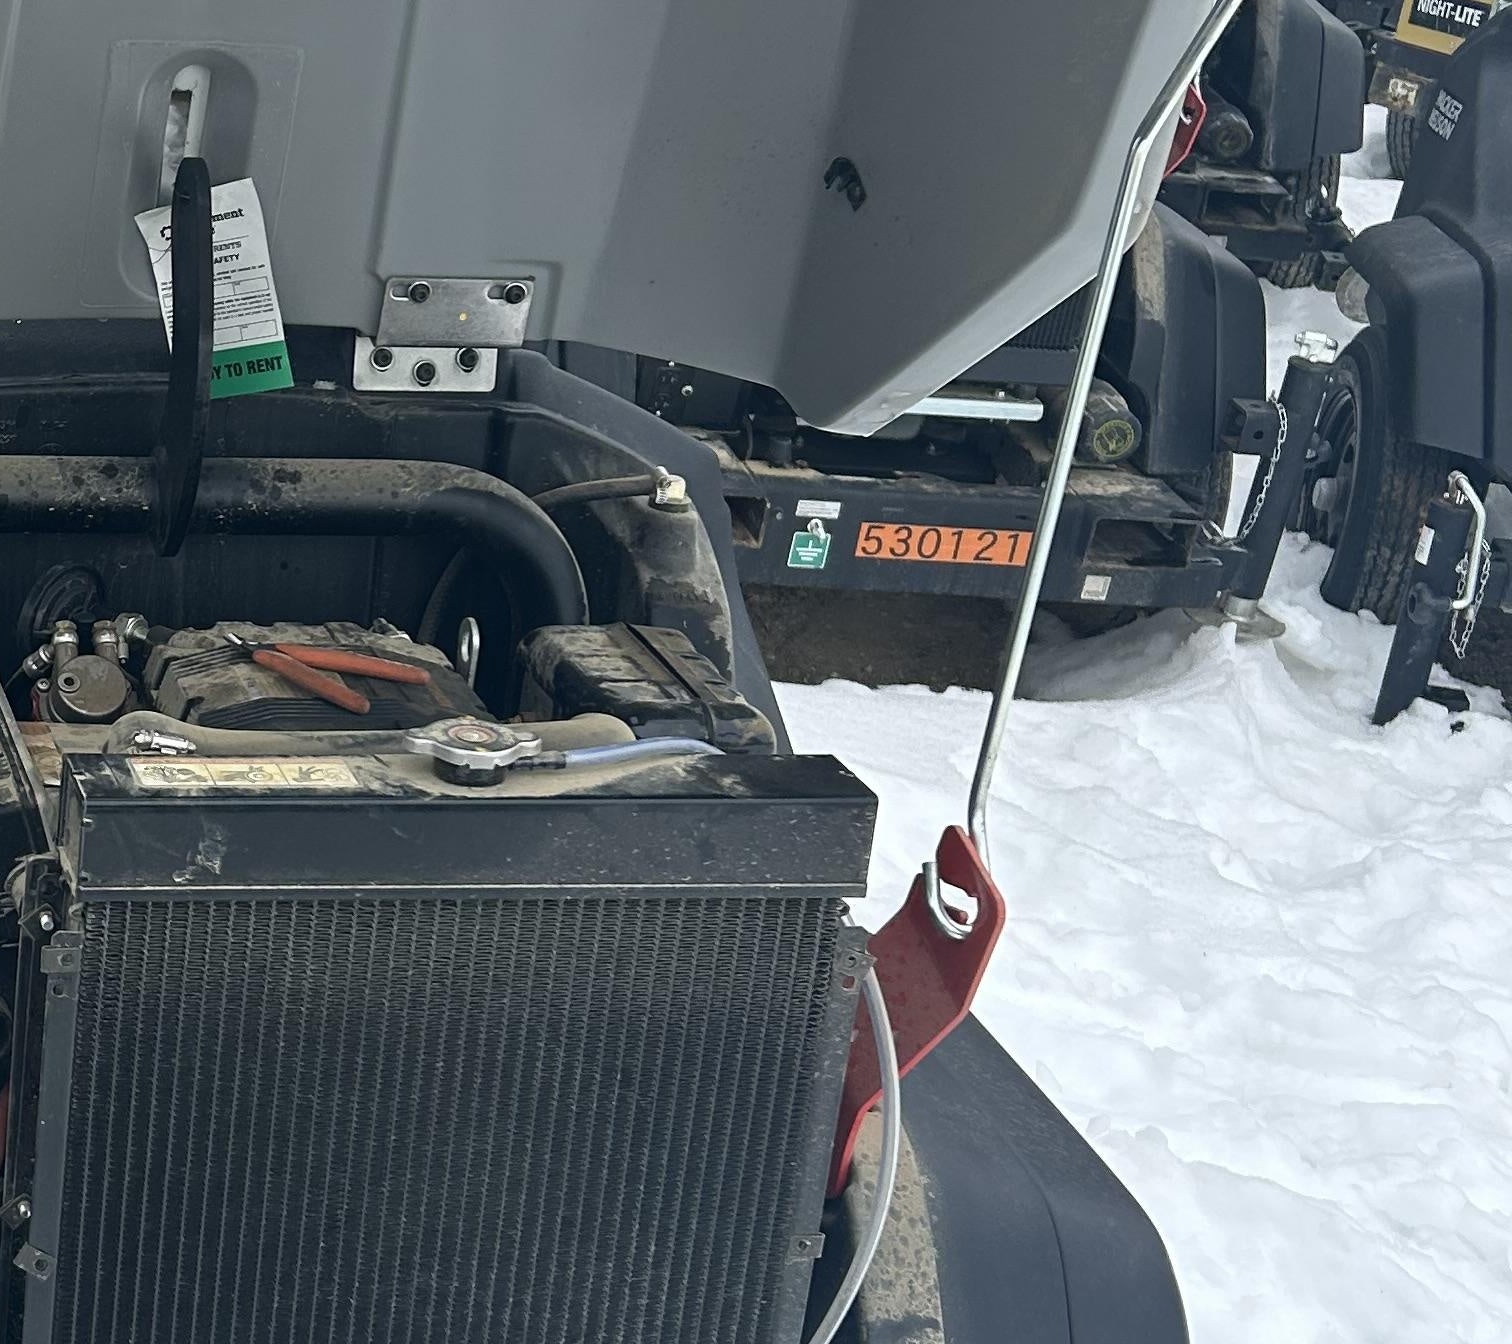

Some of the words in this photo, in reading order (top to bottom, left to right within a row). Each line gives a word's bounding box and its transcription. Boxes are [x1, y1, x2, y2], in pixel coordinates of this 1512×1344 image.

[213, 252, 240, 266] AFETY
[224, 361, 243, 379] TO
[247, 356, 283, 375] RENT
[860, 525, 1021, 563] 530121
